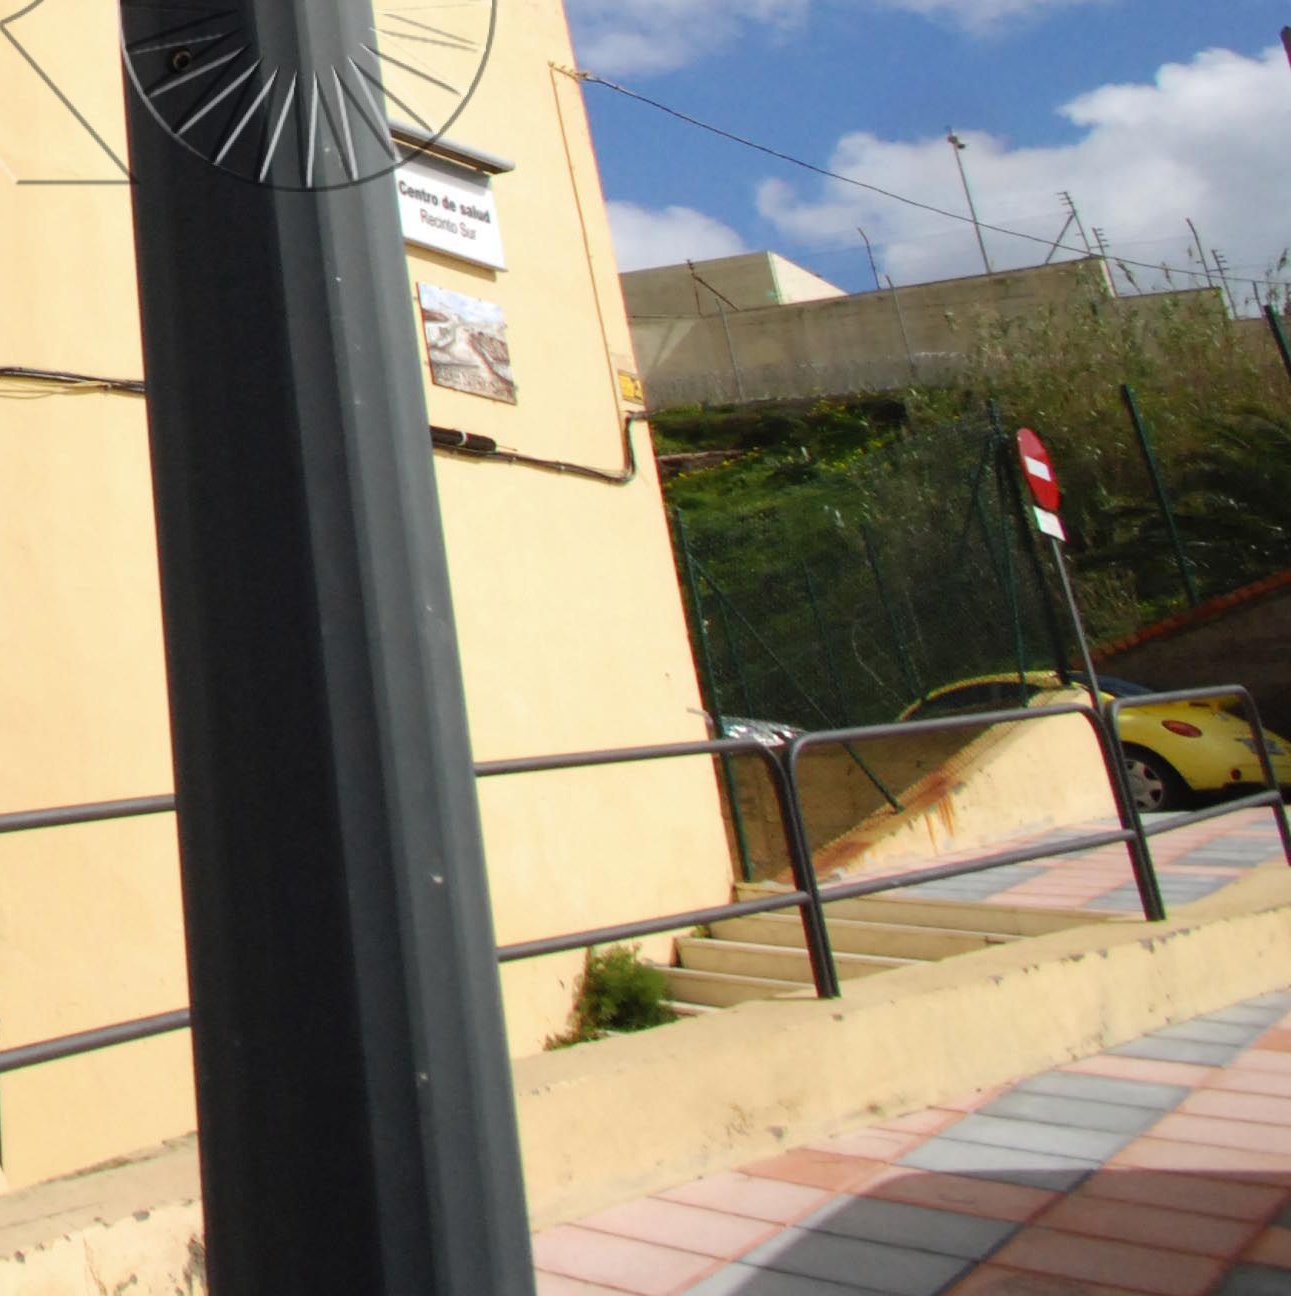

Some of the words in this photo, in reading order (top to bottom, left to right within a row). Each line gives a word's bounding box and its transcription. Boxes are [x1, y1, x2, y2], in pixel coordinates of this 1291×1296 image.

[399, 180, 438, 206] Centro
[442, 195, 456, 212] de
[460, 204, 491, 224] salud
[420, 208, 458, 234] Recinto
